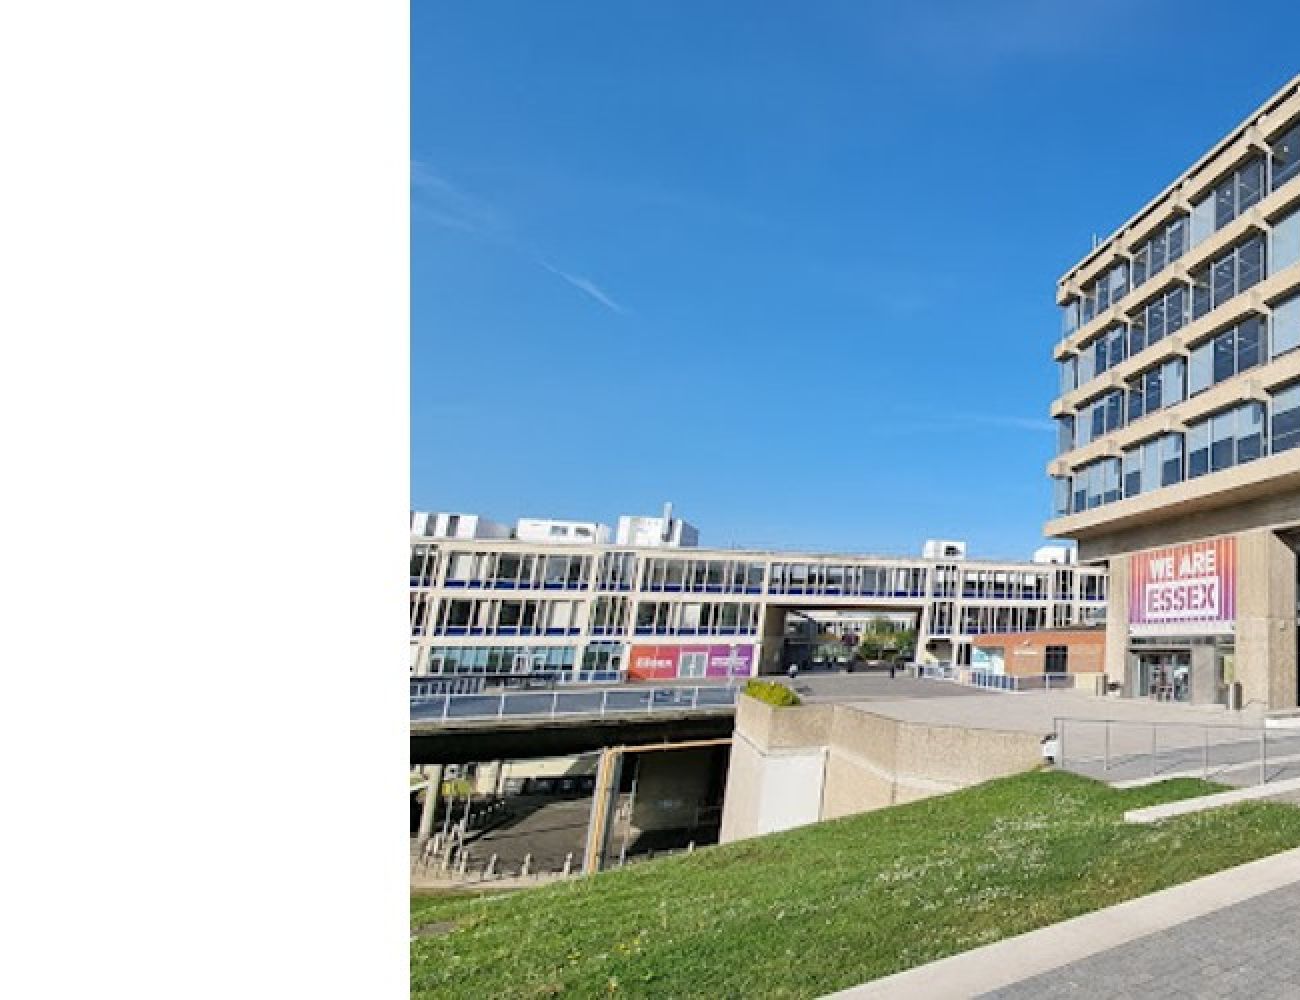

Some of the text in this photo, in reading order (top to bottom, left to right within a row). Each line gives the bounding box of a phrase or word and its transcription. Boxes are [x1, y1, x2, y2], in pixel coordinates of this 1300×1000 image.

[1150, 550, 1216, 579] WE ARE
[1147, 583, 1215, 613] ESSEX
